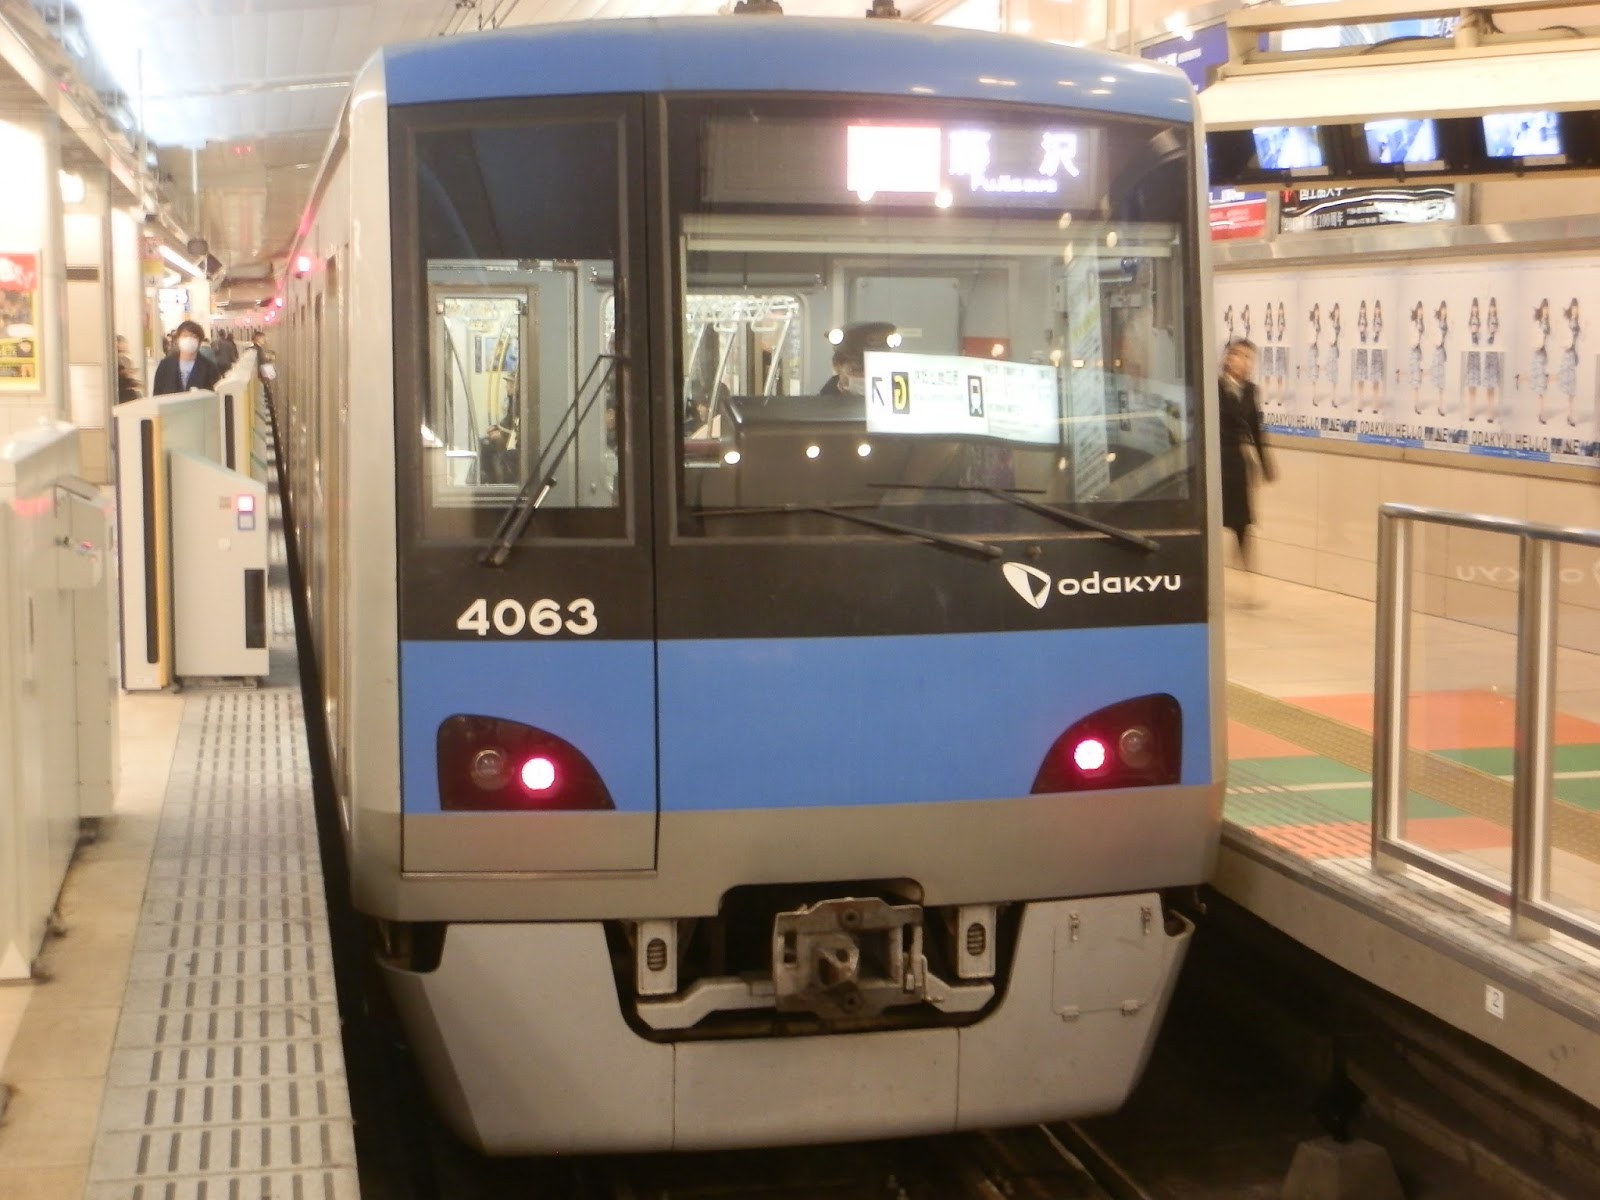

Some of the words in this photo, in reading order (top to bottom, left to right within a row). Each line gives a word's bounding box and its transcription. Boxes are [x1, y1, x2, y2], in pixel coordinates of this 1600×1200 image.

[1395, 423, 1422, 440] HELLO
[1515, 434, 1548, 452] HELLO
[1057, 571, 1182, 596] odakyu
[456, 598, 598, 636] 4063
